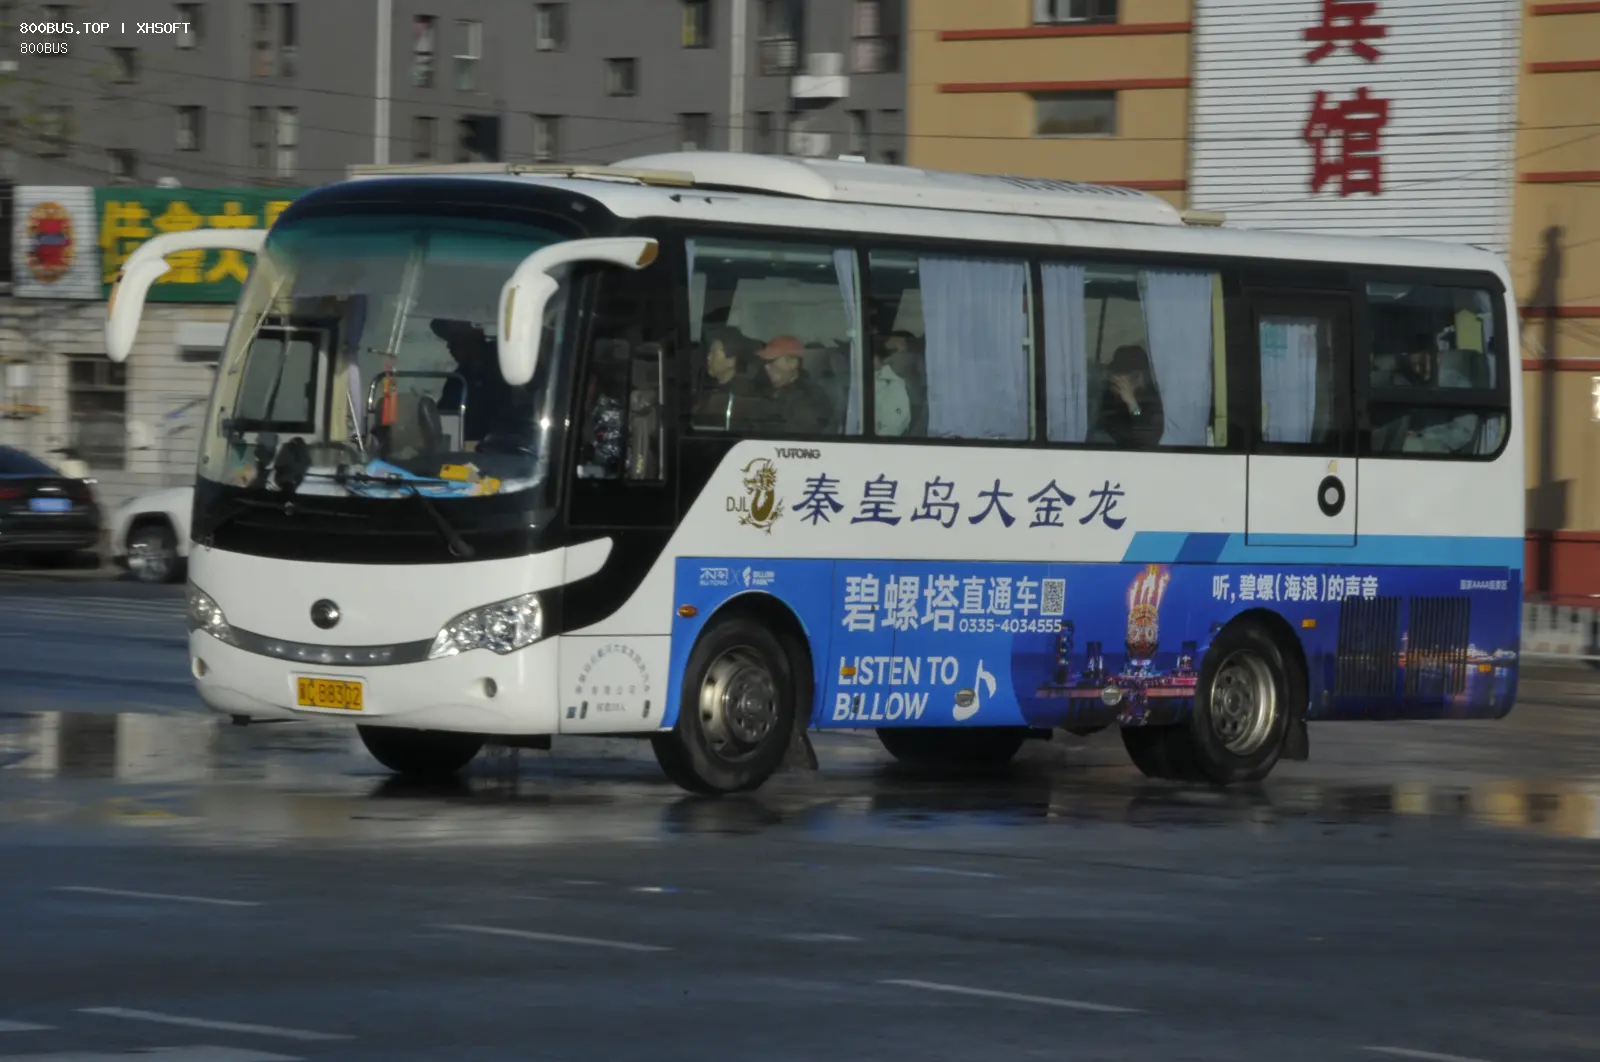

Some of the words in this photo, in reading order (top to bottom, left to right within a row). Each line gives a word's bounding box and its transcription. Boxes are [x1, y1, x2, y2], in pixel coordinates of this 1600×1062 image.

[775, 447, 821, 459] YUTONG
[726, 496, 750, 513] DJL
[791, 472, 1128, 530] 秦皇岛大金龙
[958, 617, 1063, 633] 0335-4034555
[838, 656, 922, 685] LISTEN
[926, 656, 959, 685] TO
